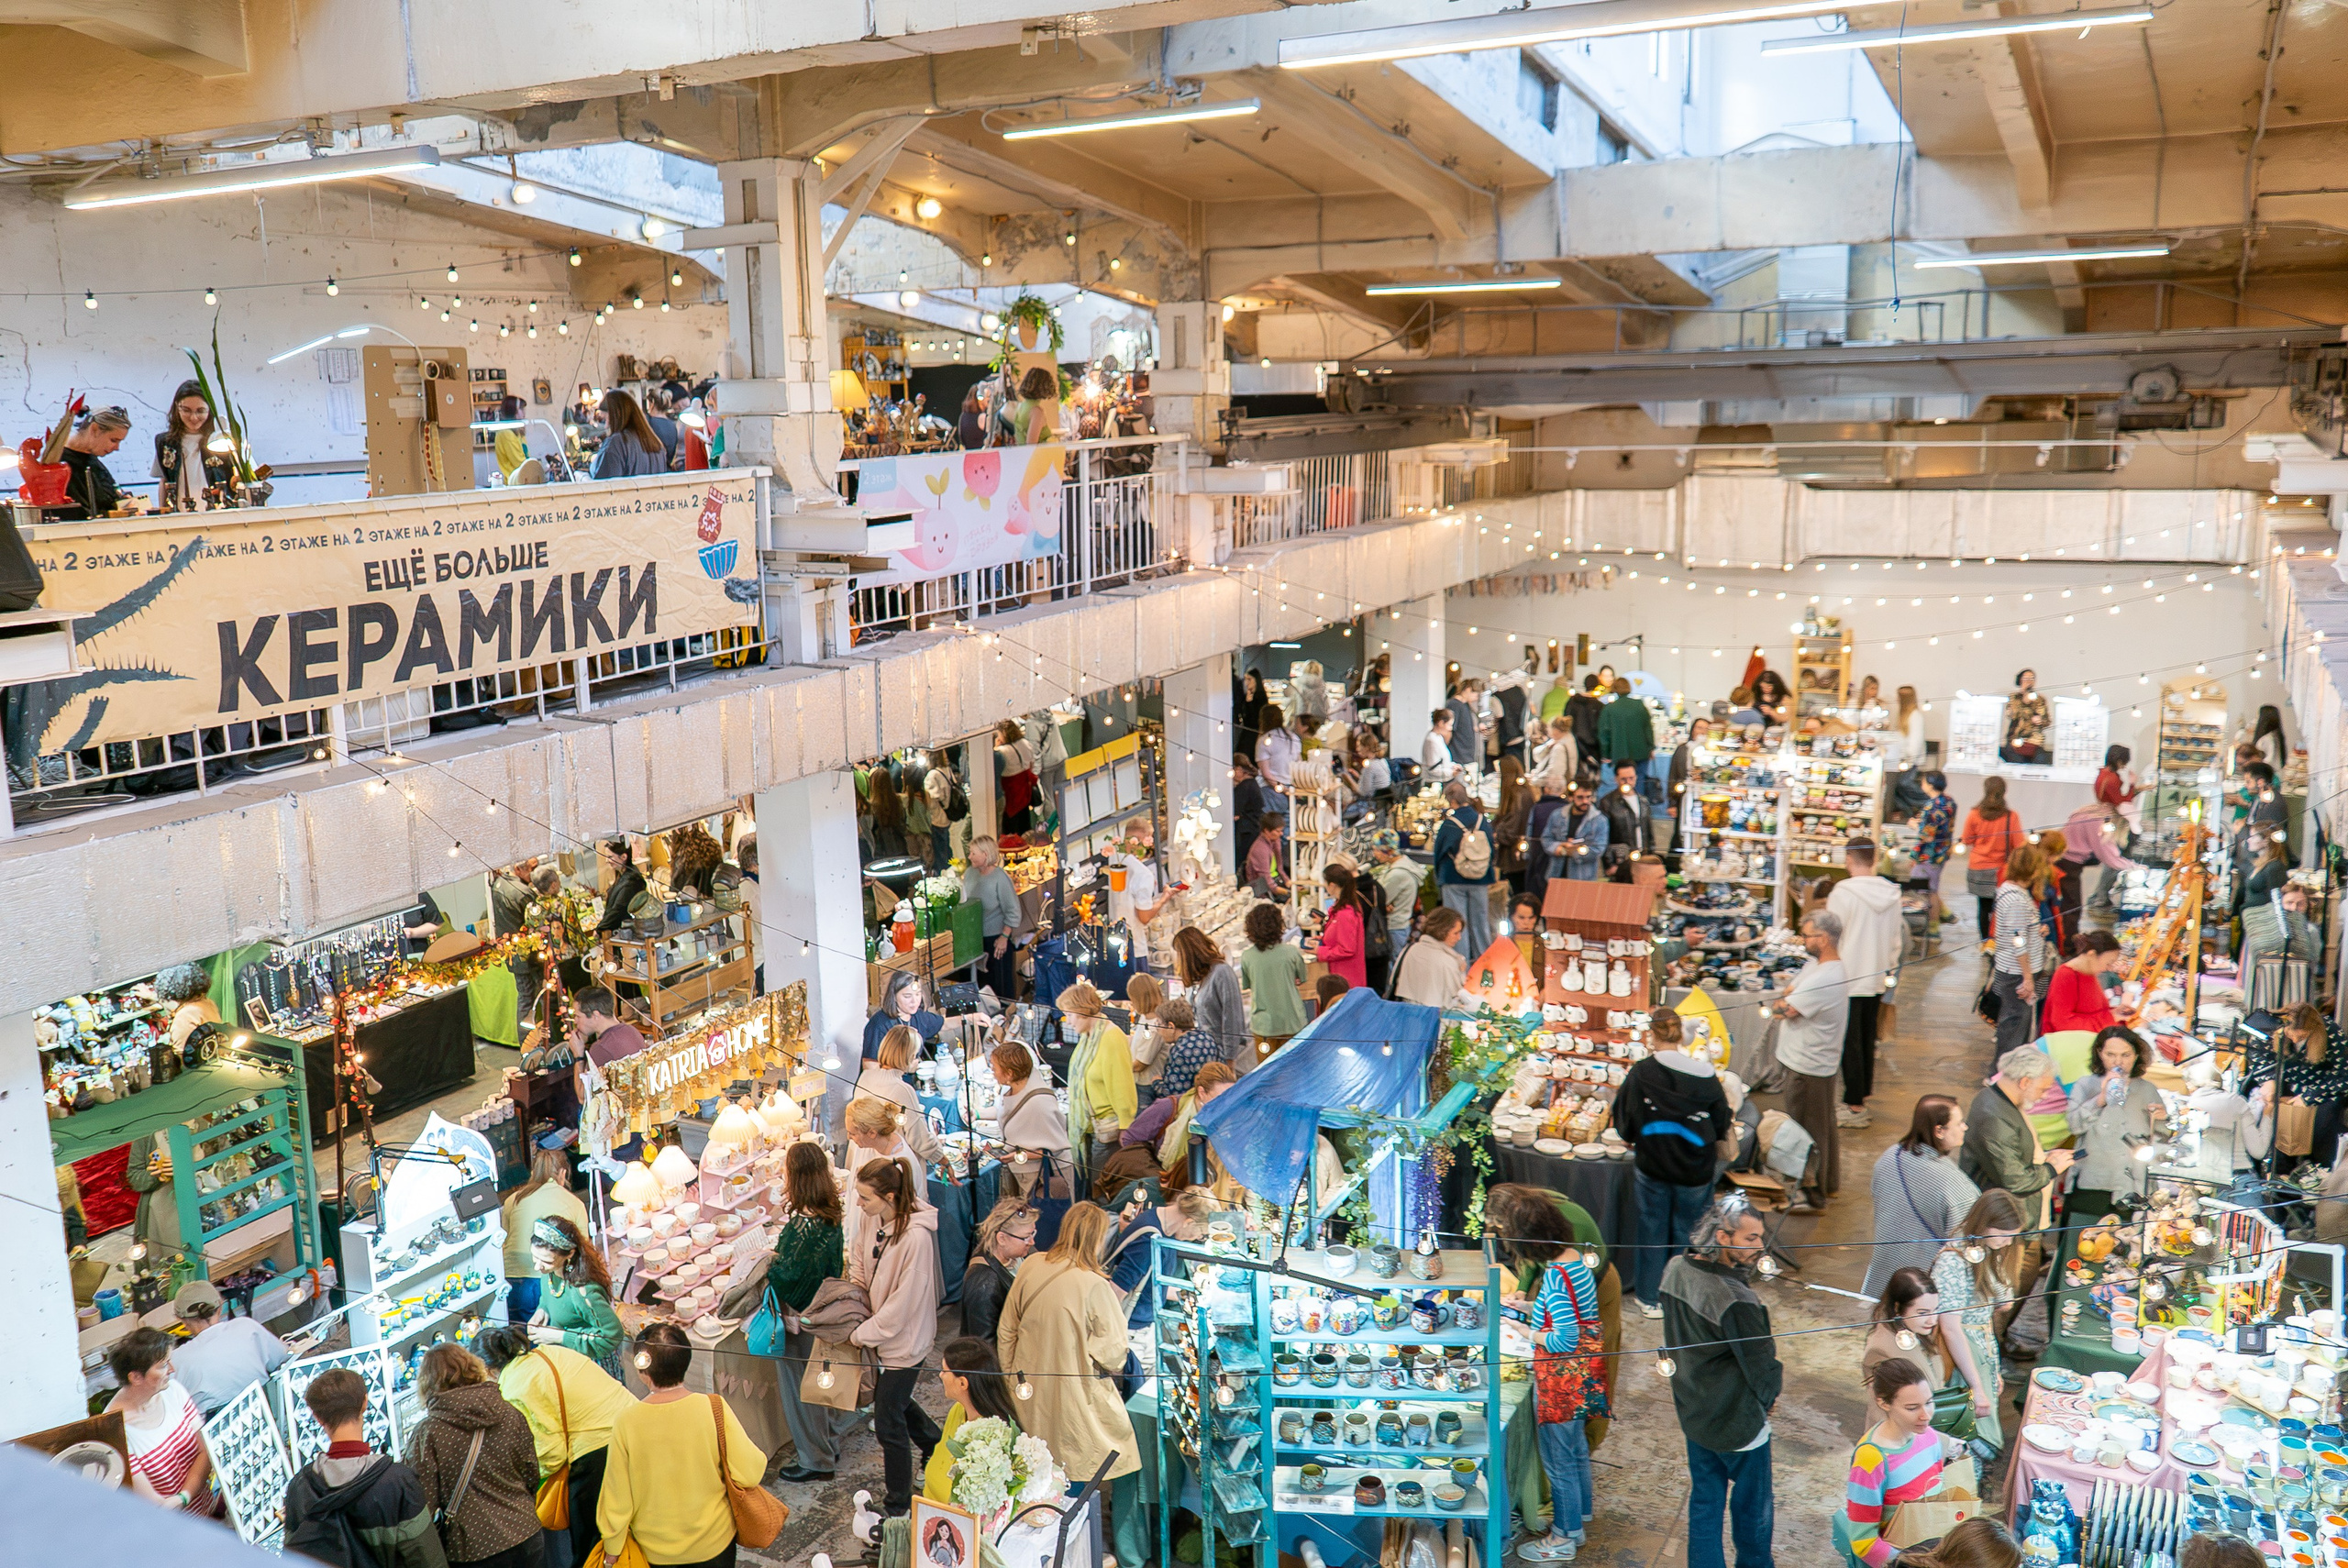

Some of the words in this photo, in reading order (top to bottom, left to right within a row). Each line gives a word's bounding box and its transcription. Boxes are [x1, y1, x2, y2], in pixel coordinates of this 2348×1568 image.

[63, 552, 79, 571] 2
[84, 552, 140, 570] ЭТАЖЕ
[147, 550, 166, 565] НА
[169, 544, 181, 562] 2
[196, 544, 237, 559] ТАЖЕ
[240, 542, 260, 556] НА
[261, 536, 275, 553] 2
[279, 535, 328, 551] ЭТАЖЕ
[333, 534, 351, 547] НА
[354, 527, 365, 545] 2
[369, 527, 411, 543] ЭТАЖЕ
[414, 525, 430, 538] НА
[433, 520, 443, 536] 2
[447, 519, 485, 535] ЭТАЖЕ
[488, 518, 503, 531] НА
[505, 513, 515, 528] 2
[518, 513, 553, 526] ЭТАЖЕ
[556, 511, 570, 523] НА
[572, 505, 581, 521] 2
[583, 505, 618, 519] ЭТАЖЕ
[620, 505, 632, 516] НА
[634, 499, 642, 514] 2
[645, 499, 675, 513] ЭТАЖЕ
[678, 498, 689, 509] НА
[692, 494, 699, 509] 2
[732, 492, 744, 503] НА
[748, 489, 755, 502] 2
[364, 547, 427, 592] ЕЩЁ
[434, 541, 549, 582] БОЛЬШЕ
[217, 561, 658, 713] КЕРАМИКИ
[647, 1043, 710, 1096] KATRIA
[725, 1013, 770, 1058] HOME
